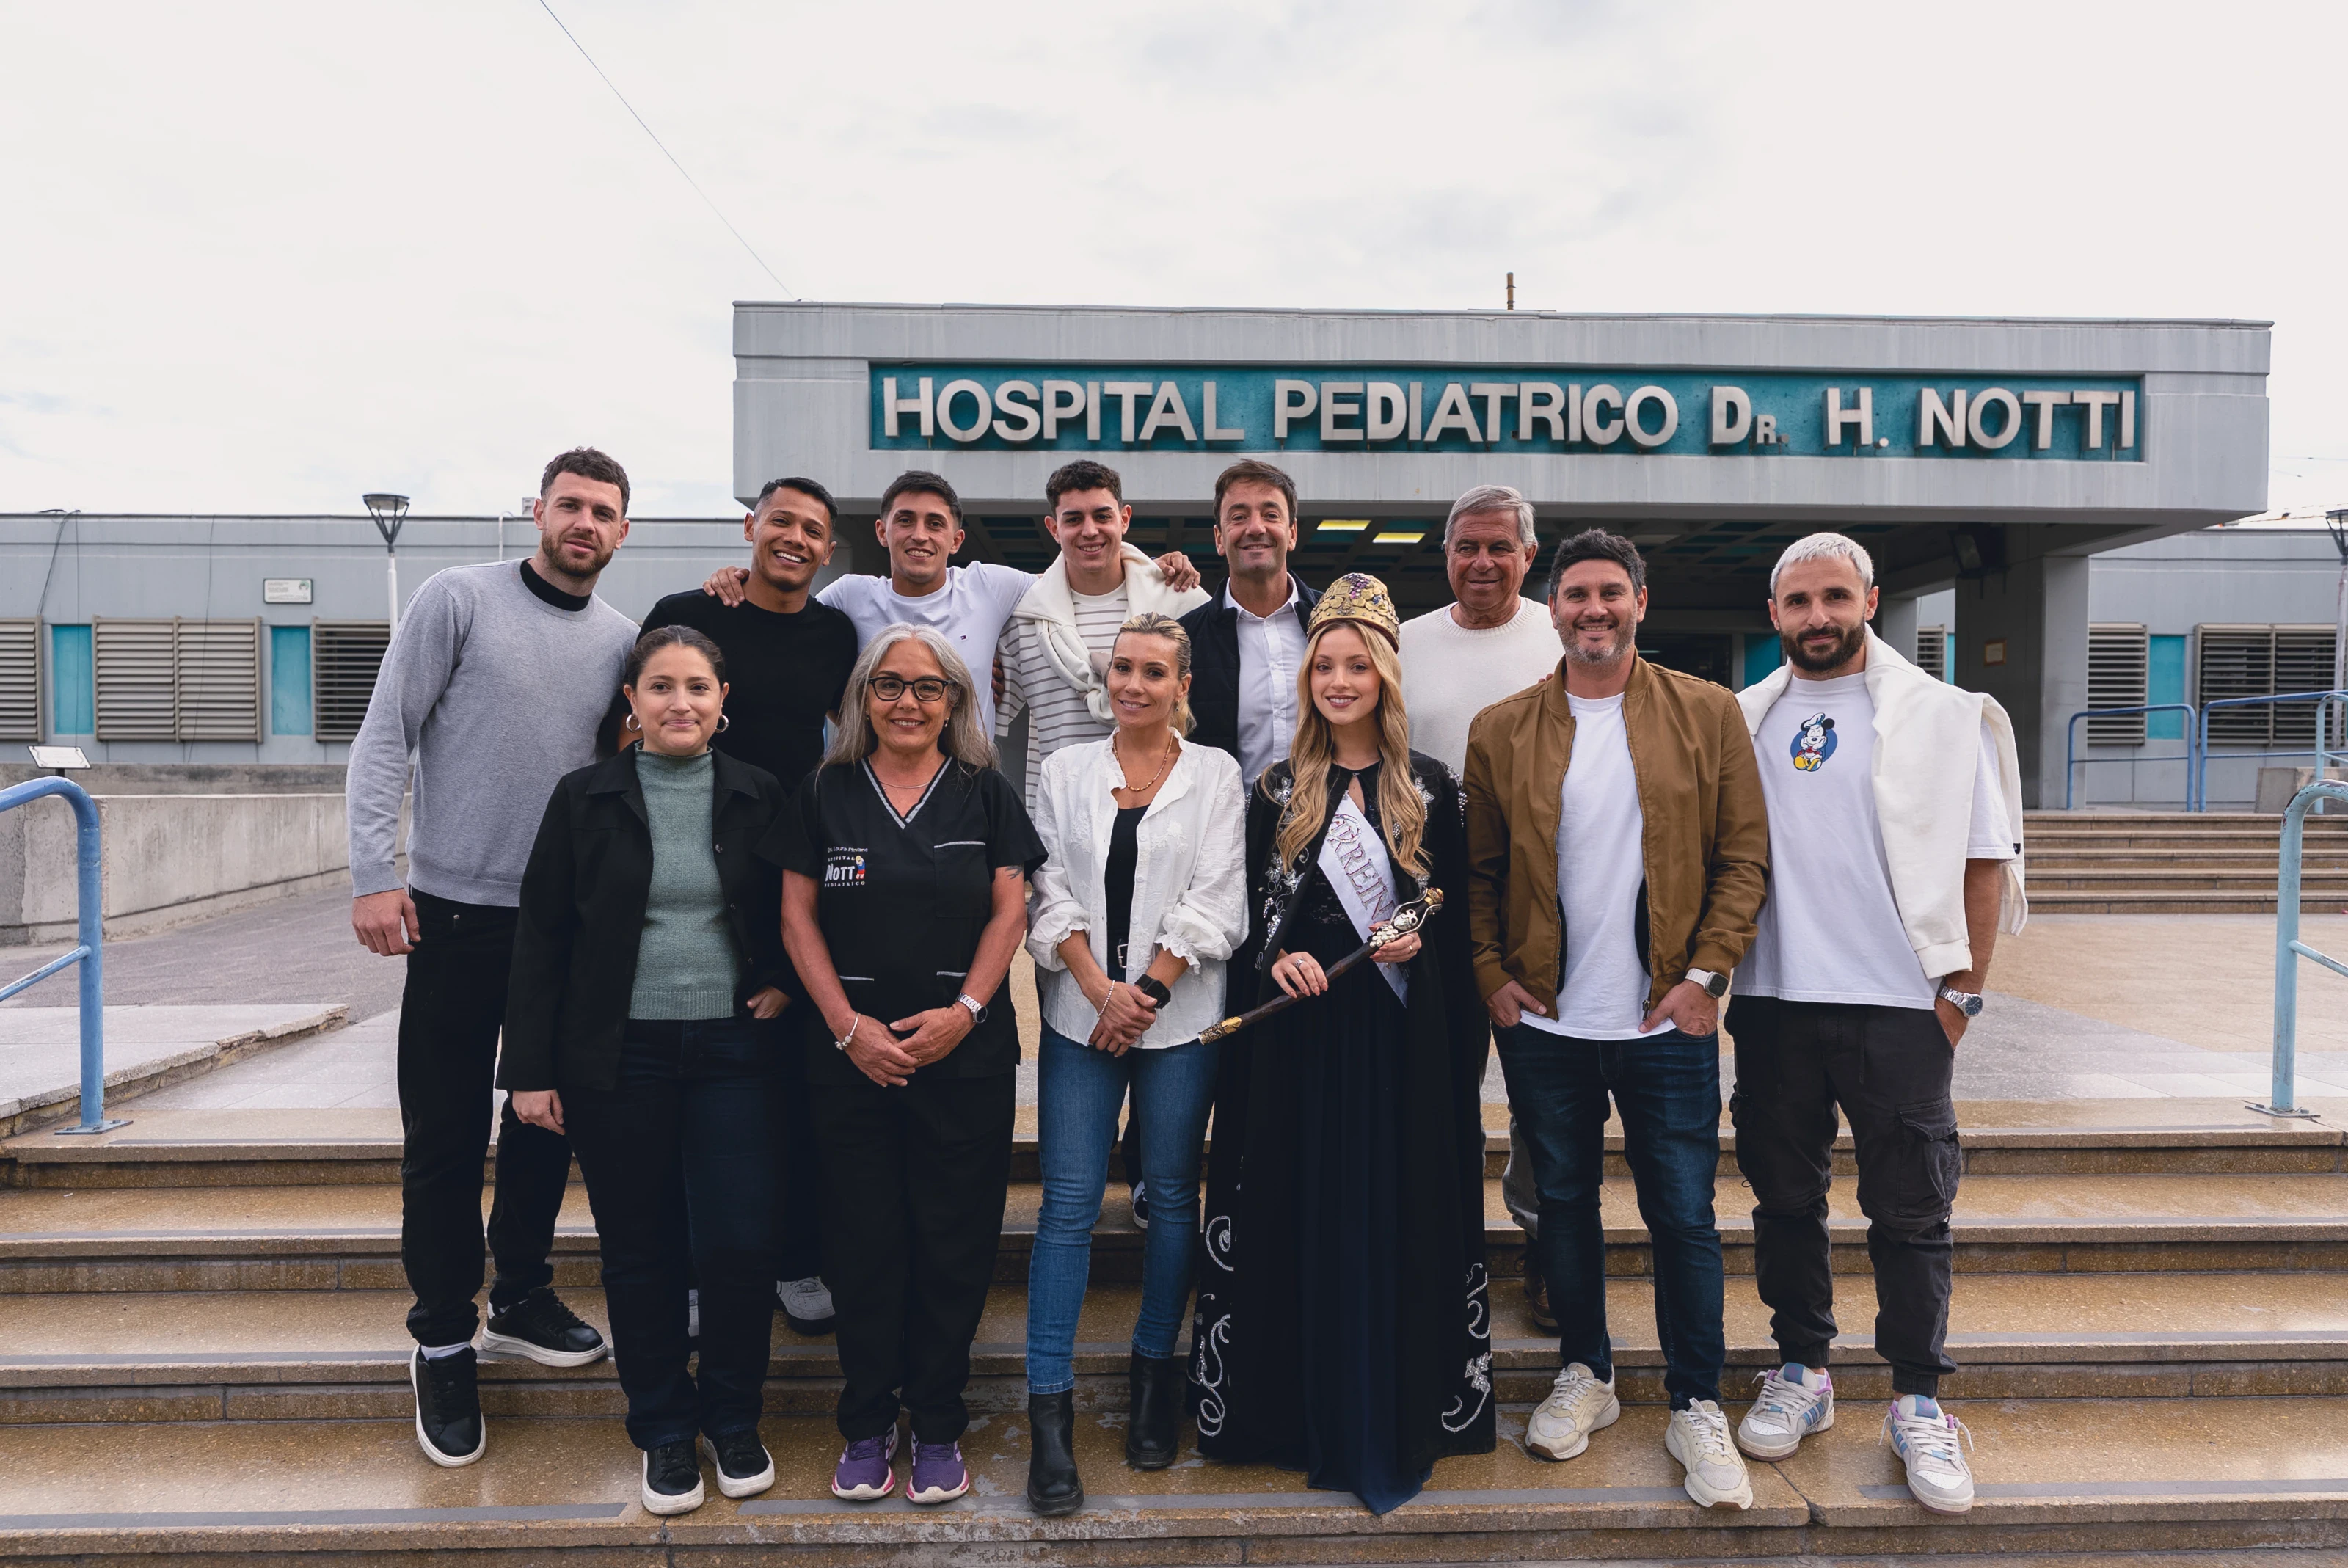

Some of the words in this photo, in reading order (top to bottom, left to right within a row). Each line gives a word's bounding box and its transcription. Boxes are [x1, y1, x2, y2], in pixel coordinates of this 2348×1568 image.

[883, 376, 1245, 443] HOSPITAL
[1275, 379, 1679, 447] PEDIATRICO
[1822, 387, 1889, 448] H.
[1915, 387, 2135, 450] NOTTI
